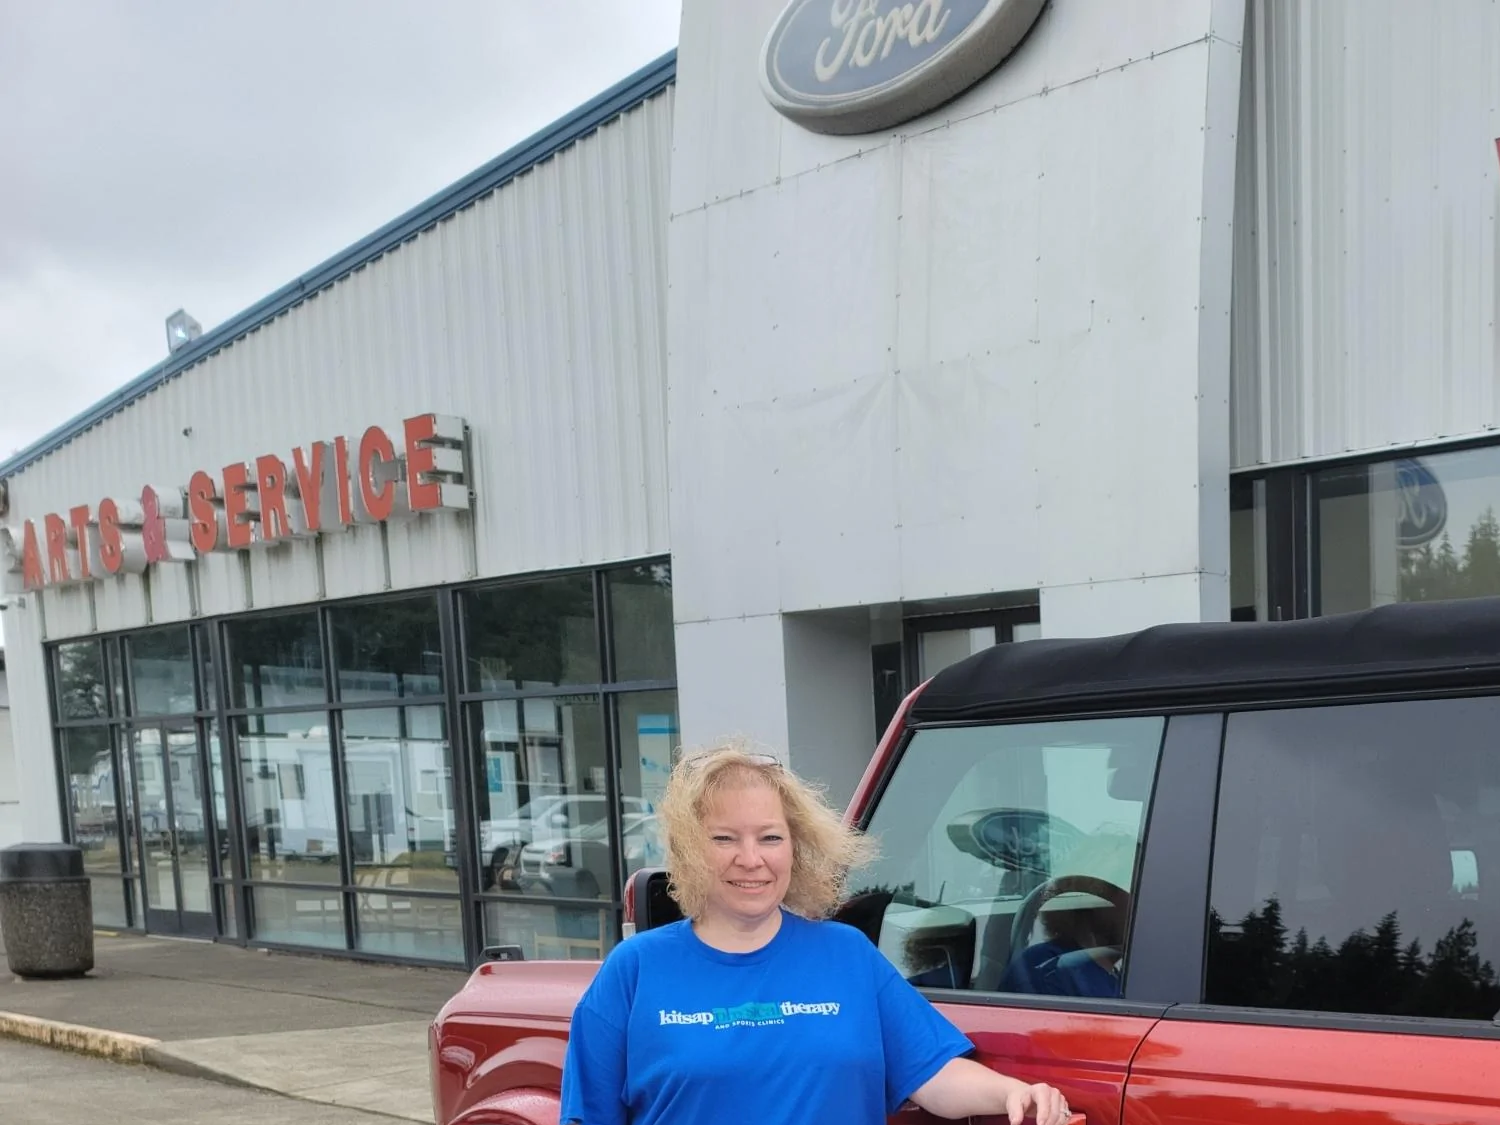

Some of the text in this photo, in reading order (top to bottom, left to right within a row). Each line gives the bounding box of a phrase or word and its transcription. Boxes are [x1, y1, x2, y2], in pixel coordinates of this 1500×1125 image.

[14, 413, 447, 590] ARTS & SERVICE
[659, 1009, 714, 1026] kitsap
[780, 1001, 840, 1016] therapy
